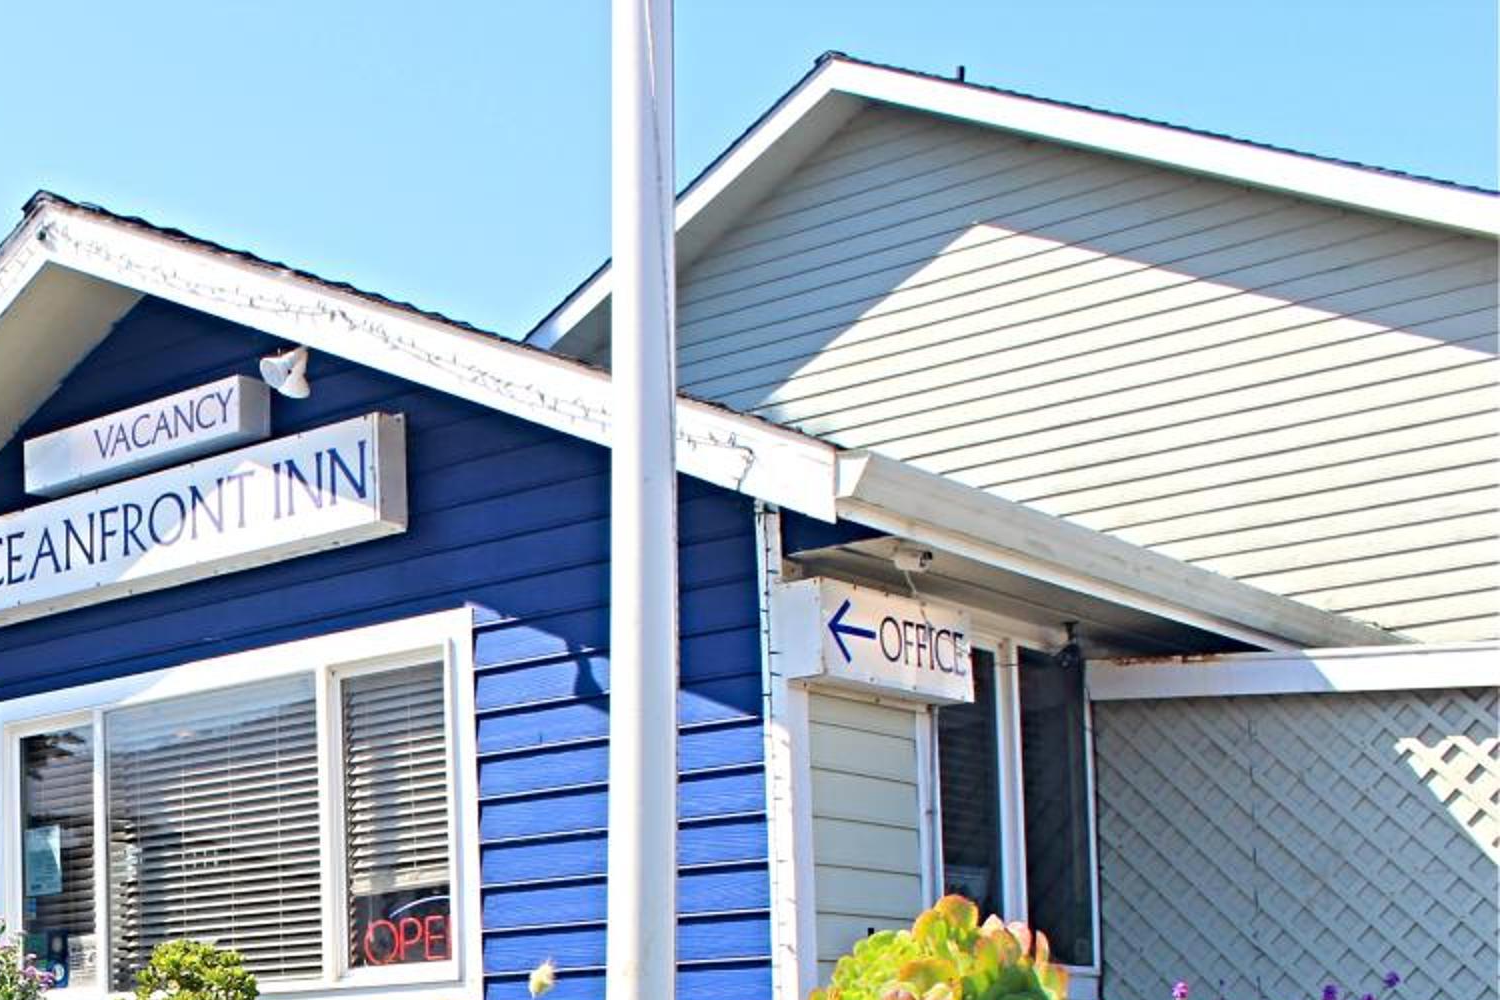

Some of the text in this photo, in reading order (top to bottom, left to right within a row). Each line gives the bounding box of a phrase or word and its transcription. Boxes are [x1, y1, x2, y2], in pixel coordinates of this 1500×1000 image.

[93, 386, 235, 460] VACANCY
[271, 439, 368, 520] INN
[879, 616, 967, 676] OFFICE
[363, 914, 452, 965] OPE
